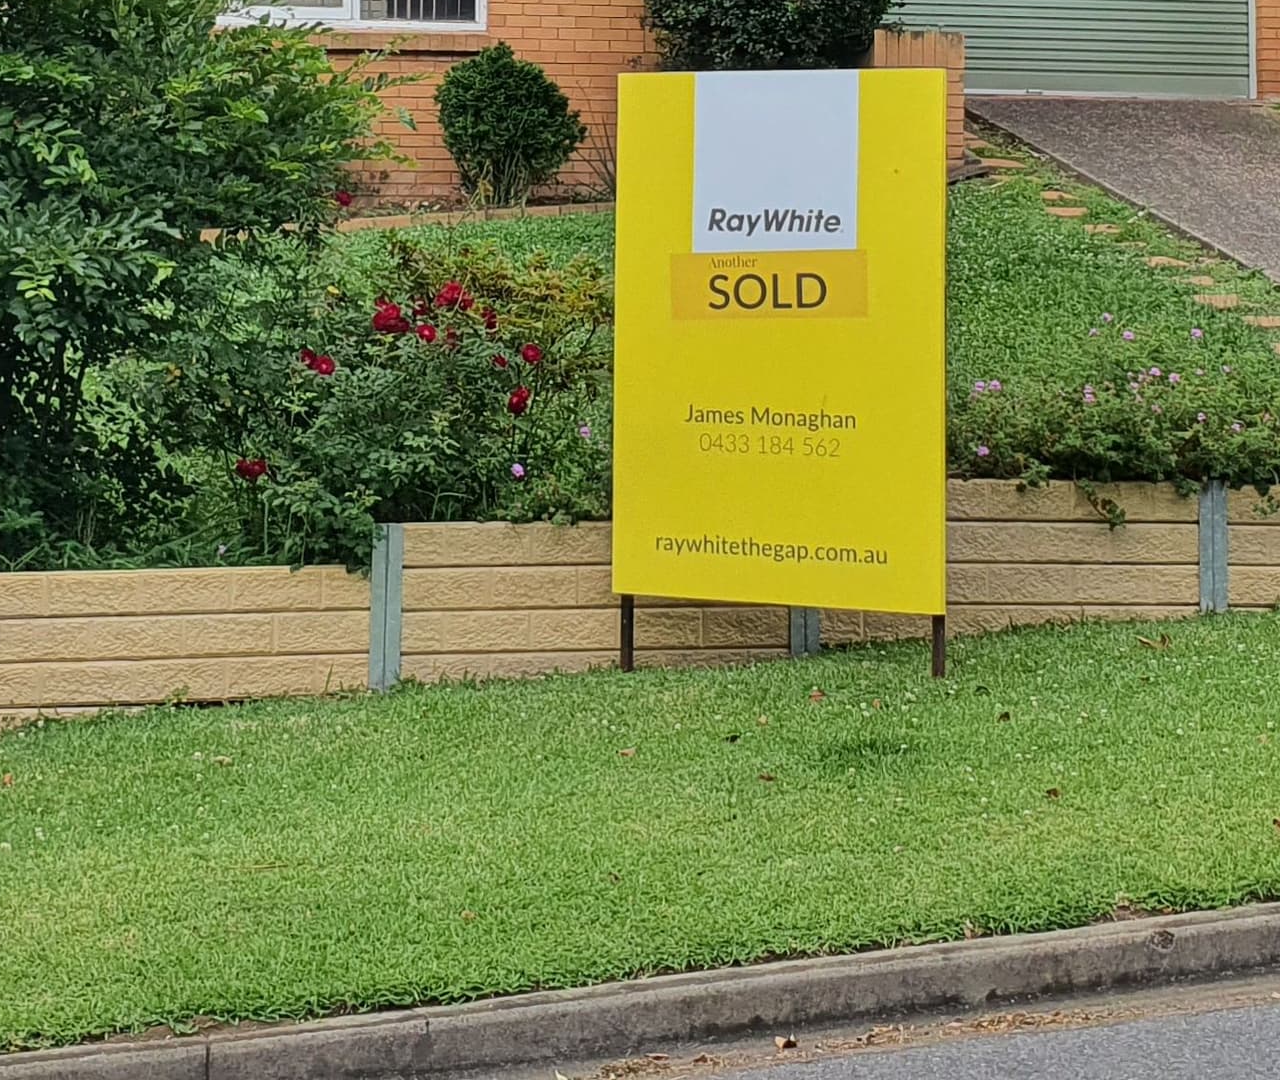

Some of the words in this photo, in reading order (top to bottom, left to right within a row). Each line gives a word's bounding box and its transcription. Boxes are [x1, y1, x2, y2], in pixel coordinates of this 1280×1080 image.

[709, 255, 758, 269] Another
[709, 273, 827, 310] SOLD
[685, 404, 744, 425] James
[751, 407, 857, 431] Monaghan
[699, 433, 750, 454] 0433
[758, 436, 795, 456] 184
[802, 438, 841, 457] 562
[655, 534, 888, 565] raywhitethegap.com.au
